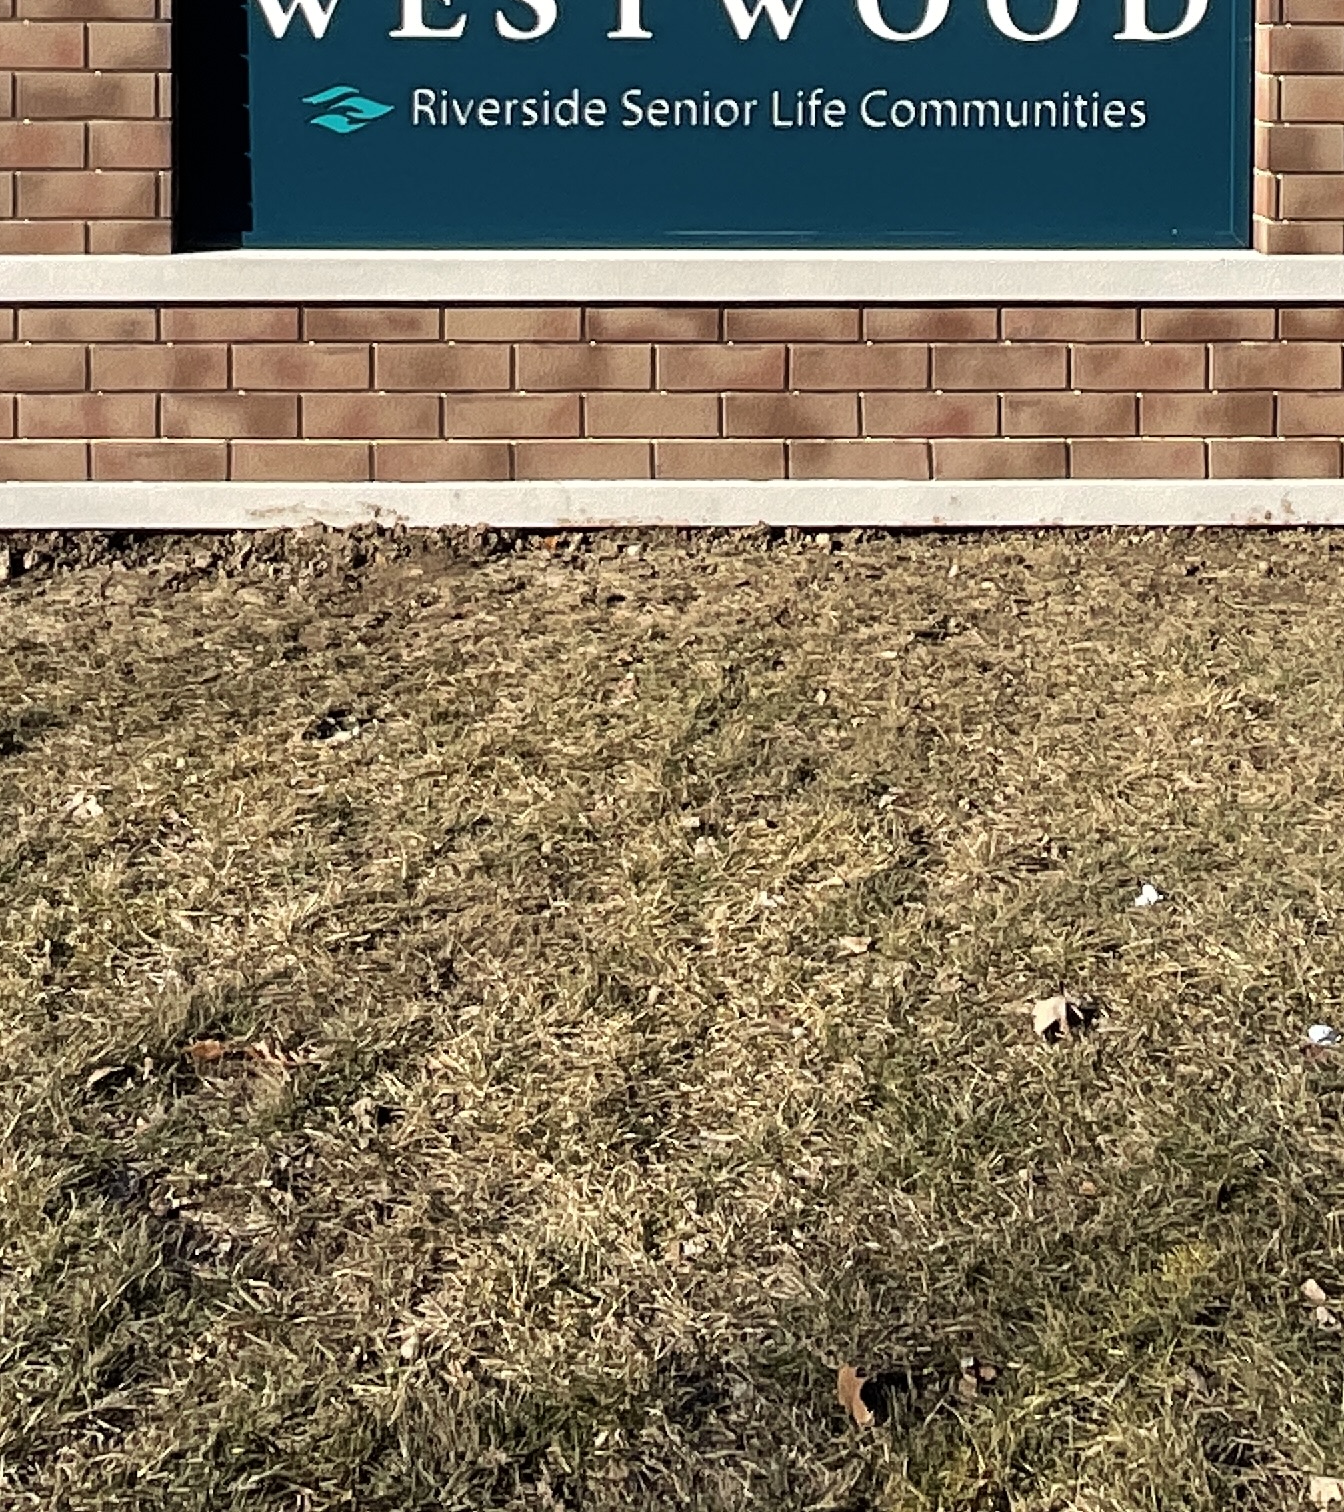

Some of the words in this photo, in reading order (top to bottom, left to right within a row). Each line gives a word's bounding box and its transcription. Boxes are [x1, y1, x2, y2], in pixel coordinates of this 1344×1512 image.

[412, 88, 607, 128] Riverside
[622, 88, 758, 128] Senior
[772, 87, 847, 128] Life
[860, 89, 1146, 128] Communities
